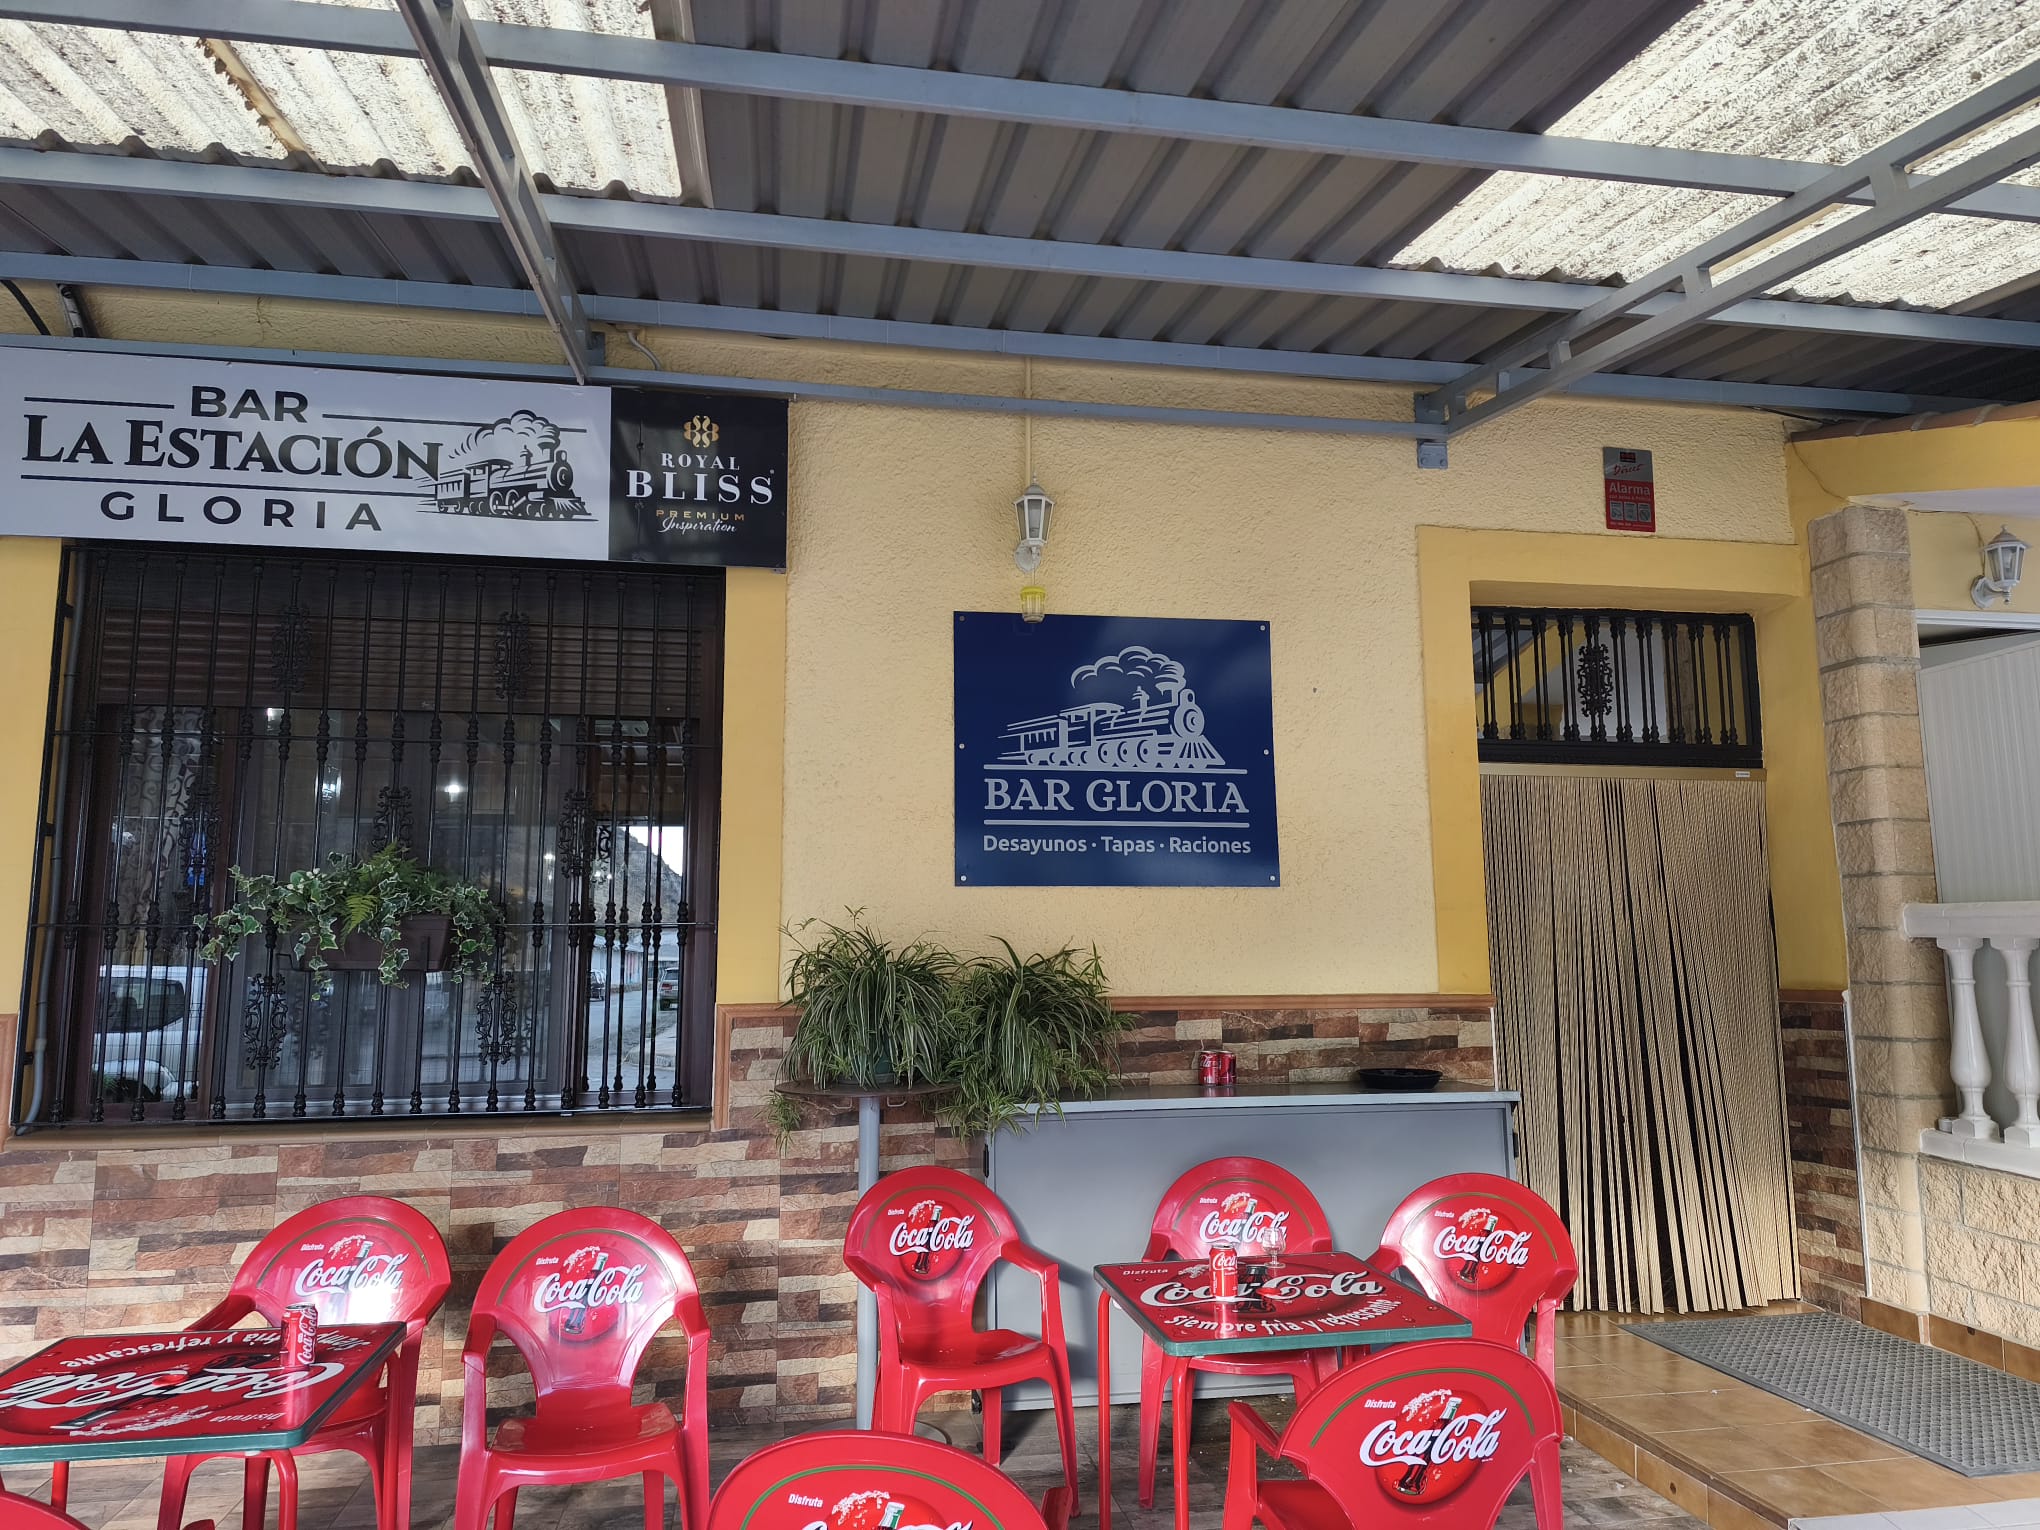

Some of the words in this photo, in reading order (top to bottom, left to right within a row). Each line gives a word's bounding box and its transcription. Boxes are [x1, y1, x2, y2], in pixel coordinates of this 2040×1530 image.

[191, 385, 309, 423] BAR
[22, 414, 113, 465] LA
[125, 419, 444, 481] ESTACIÓN
[661, 453, 740, 471] ROYAL
[626, 469, 773, 505] BLISS
[1609, 482, 1651, 495] Alarma
[100, 491, 382, 531] GLORIA
[656, 509, 745, 521] PREMIUM
[657, 515, 737, 535] Inspiration
[984, 778, 1074, 811] BAR
[1086, 779, 1250, 813] GLORIA
[983, 835, 1087, 855] Desayunos
[1100, 836, 1155, 856] Tapas
[1169, 837, 1251, 854] Raciones
[889, 1214, 975, 1256] Coca-Cola
[1433, 1226, 1532, 1265] Coca-Cola
[295, 1253, 409, 1297] Coca-Cola
[533, 1263, 647, 1313] Coca-Cola
[218, 1332, 239, 1346] y
[1164, 1315, 1257, 1333] Siempre
[1302, 1320, 1323, 1332] y
[59, 1336, 213, 1367] refrescante
[0, 1362, 345, 1409] Coca-Cola
[1364, 1398, 1396, 1409] Disfruta
[1359, 1407, 1507, 1467] Coca-Cola
[788, 1493, 823, 1508] Disfruta
